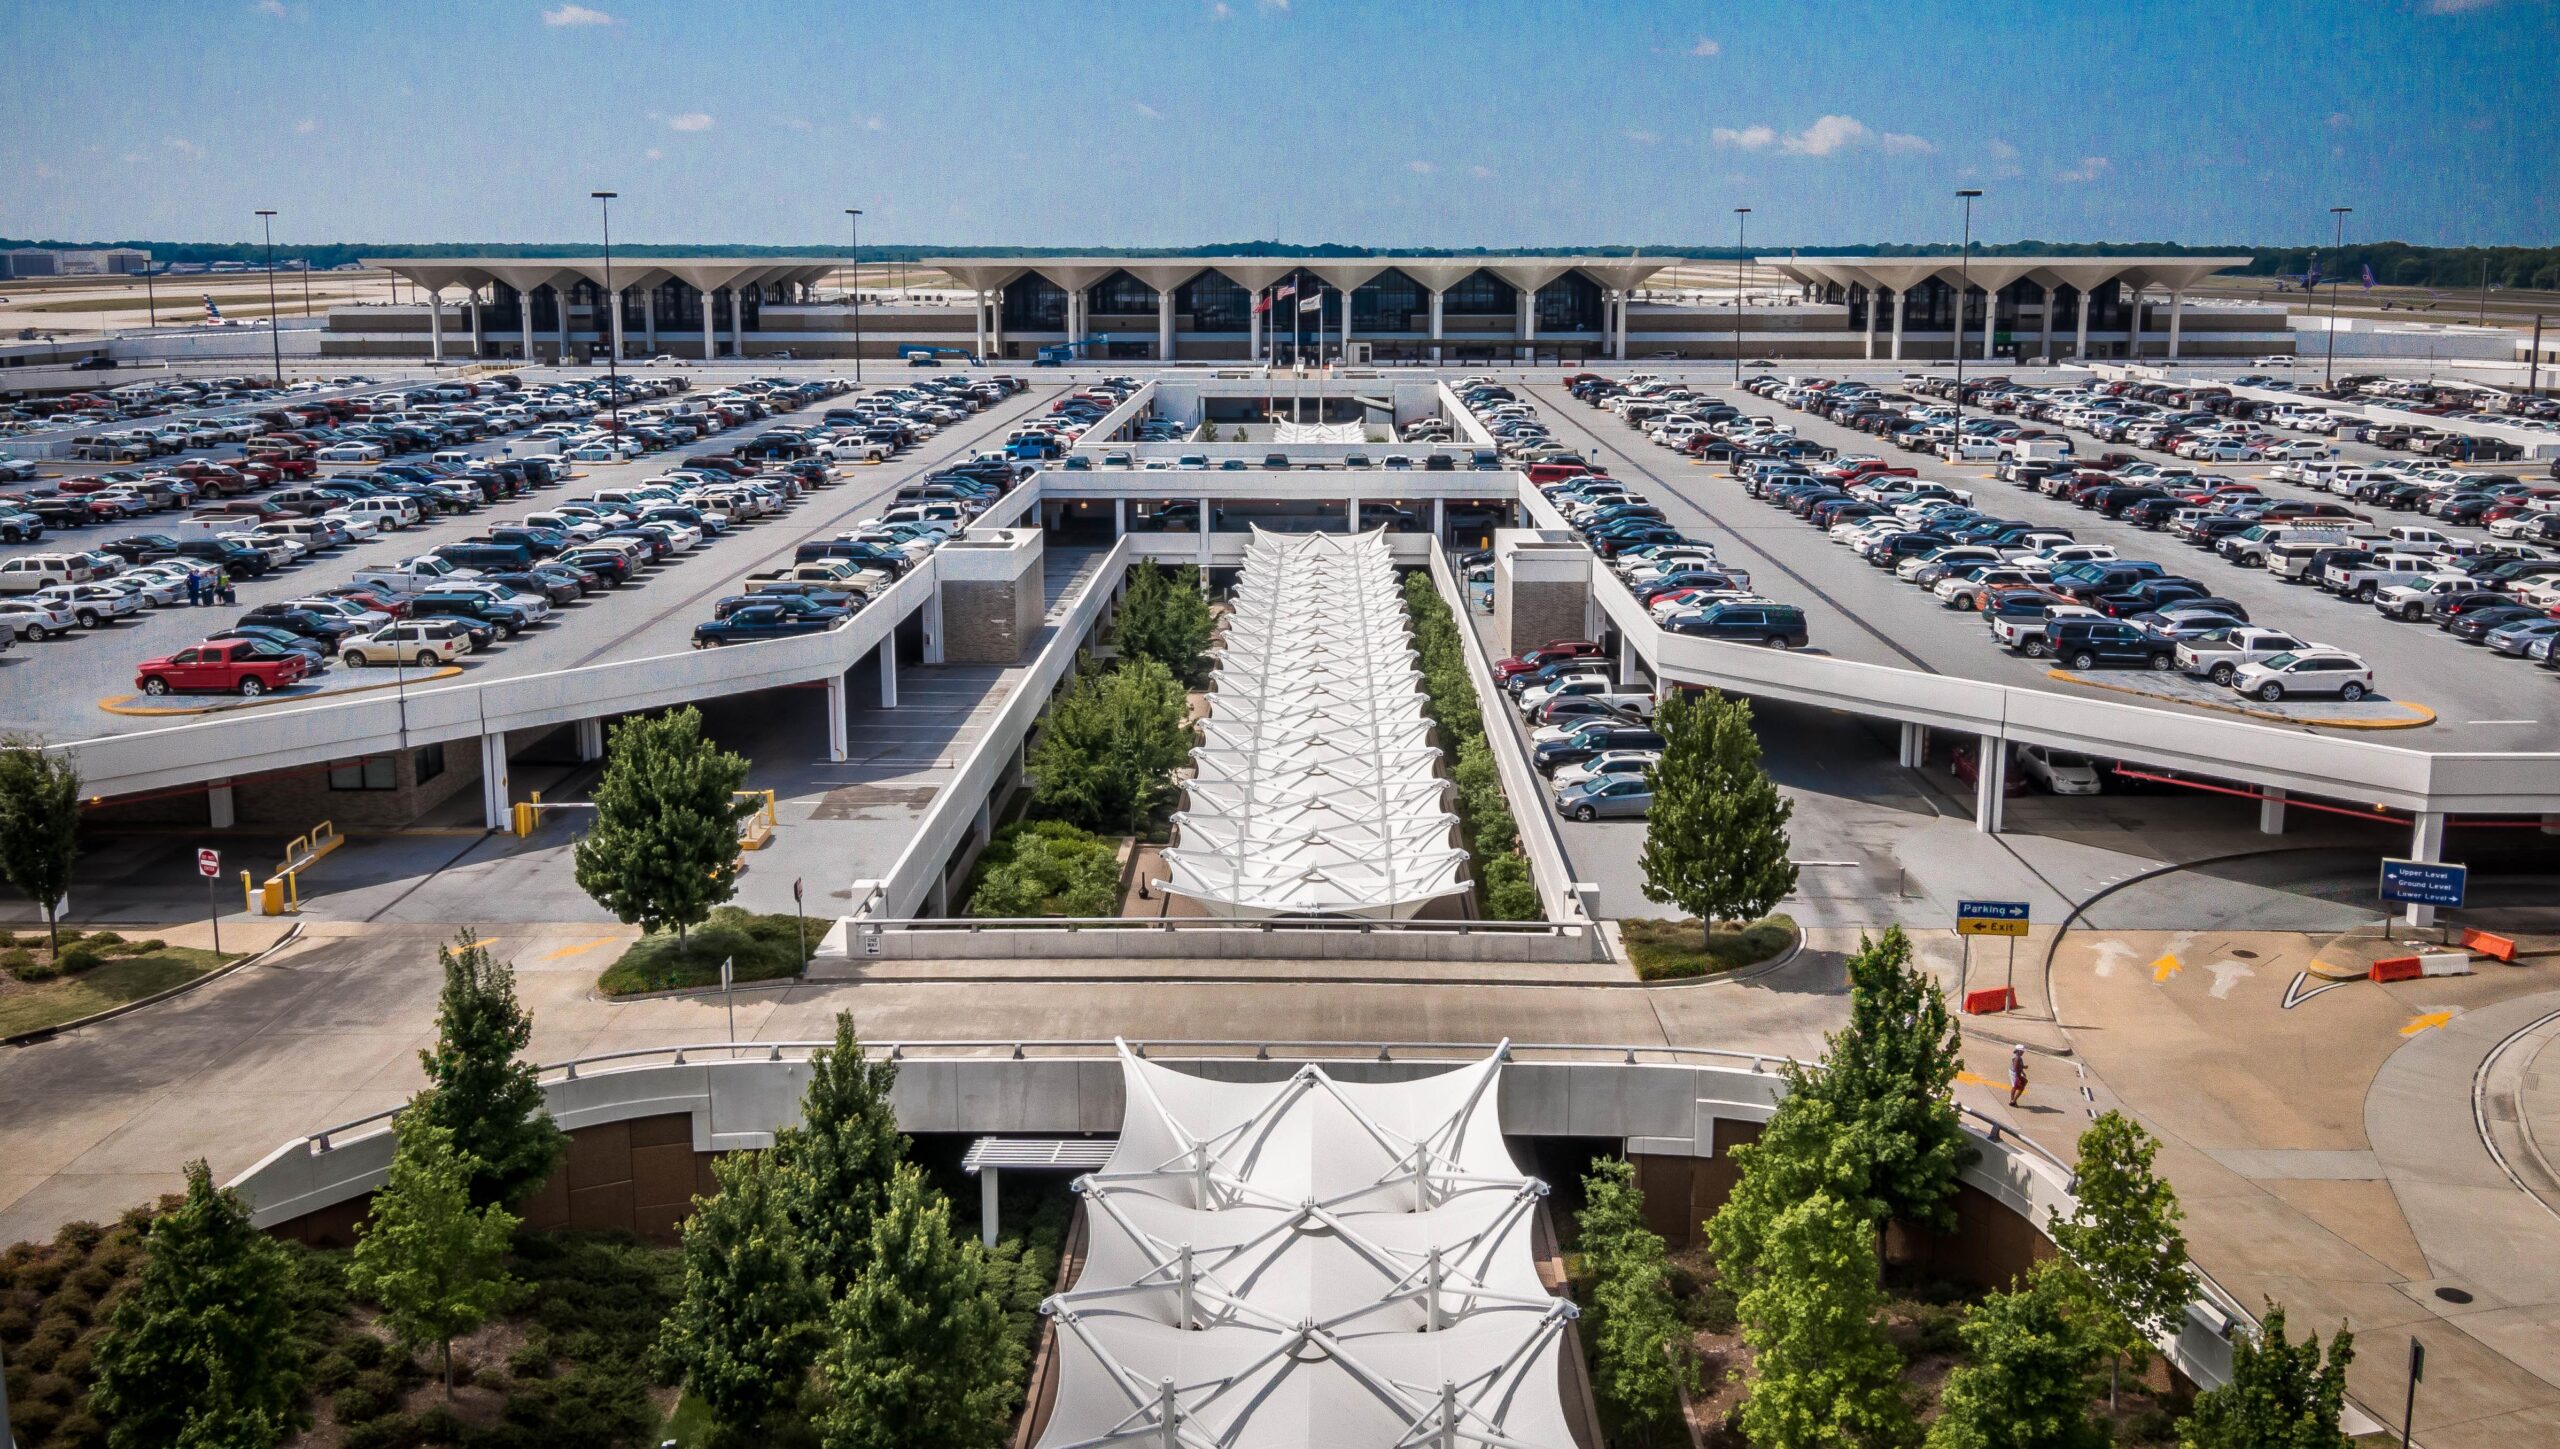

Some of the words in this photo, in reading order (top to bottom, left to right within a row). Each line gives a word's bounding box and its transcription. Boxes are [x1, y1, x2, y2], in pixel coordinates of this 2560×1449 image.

[2399, 868, 2422, 877] Upper
[2425, 871, 2448, 879] Level
[2398, 879, 2426, 888] Ground
[2429, 881, 2451, 891] Level
[2397, 890, 2422, 898] Lower
[2424, 893, 2447, 901] Level
[1963, 904, 2006, 917] Parking
[1990, 922, 2014, 932] Exit
